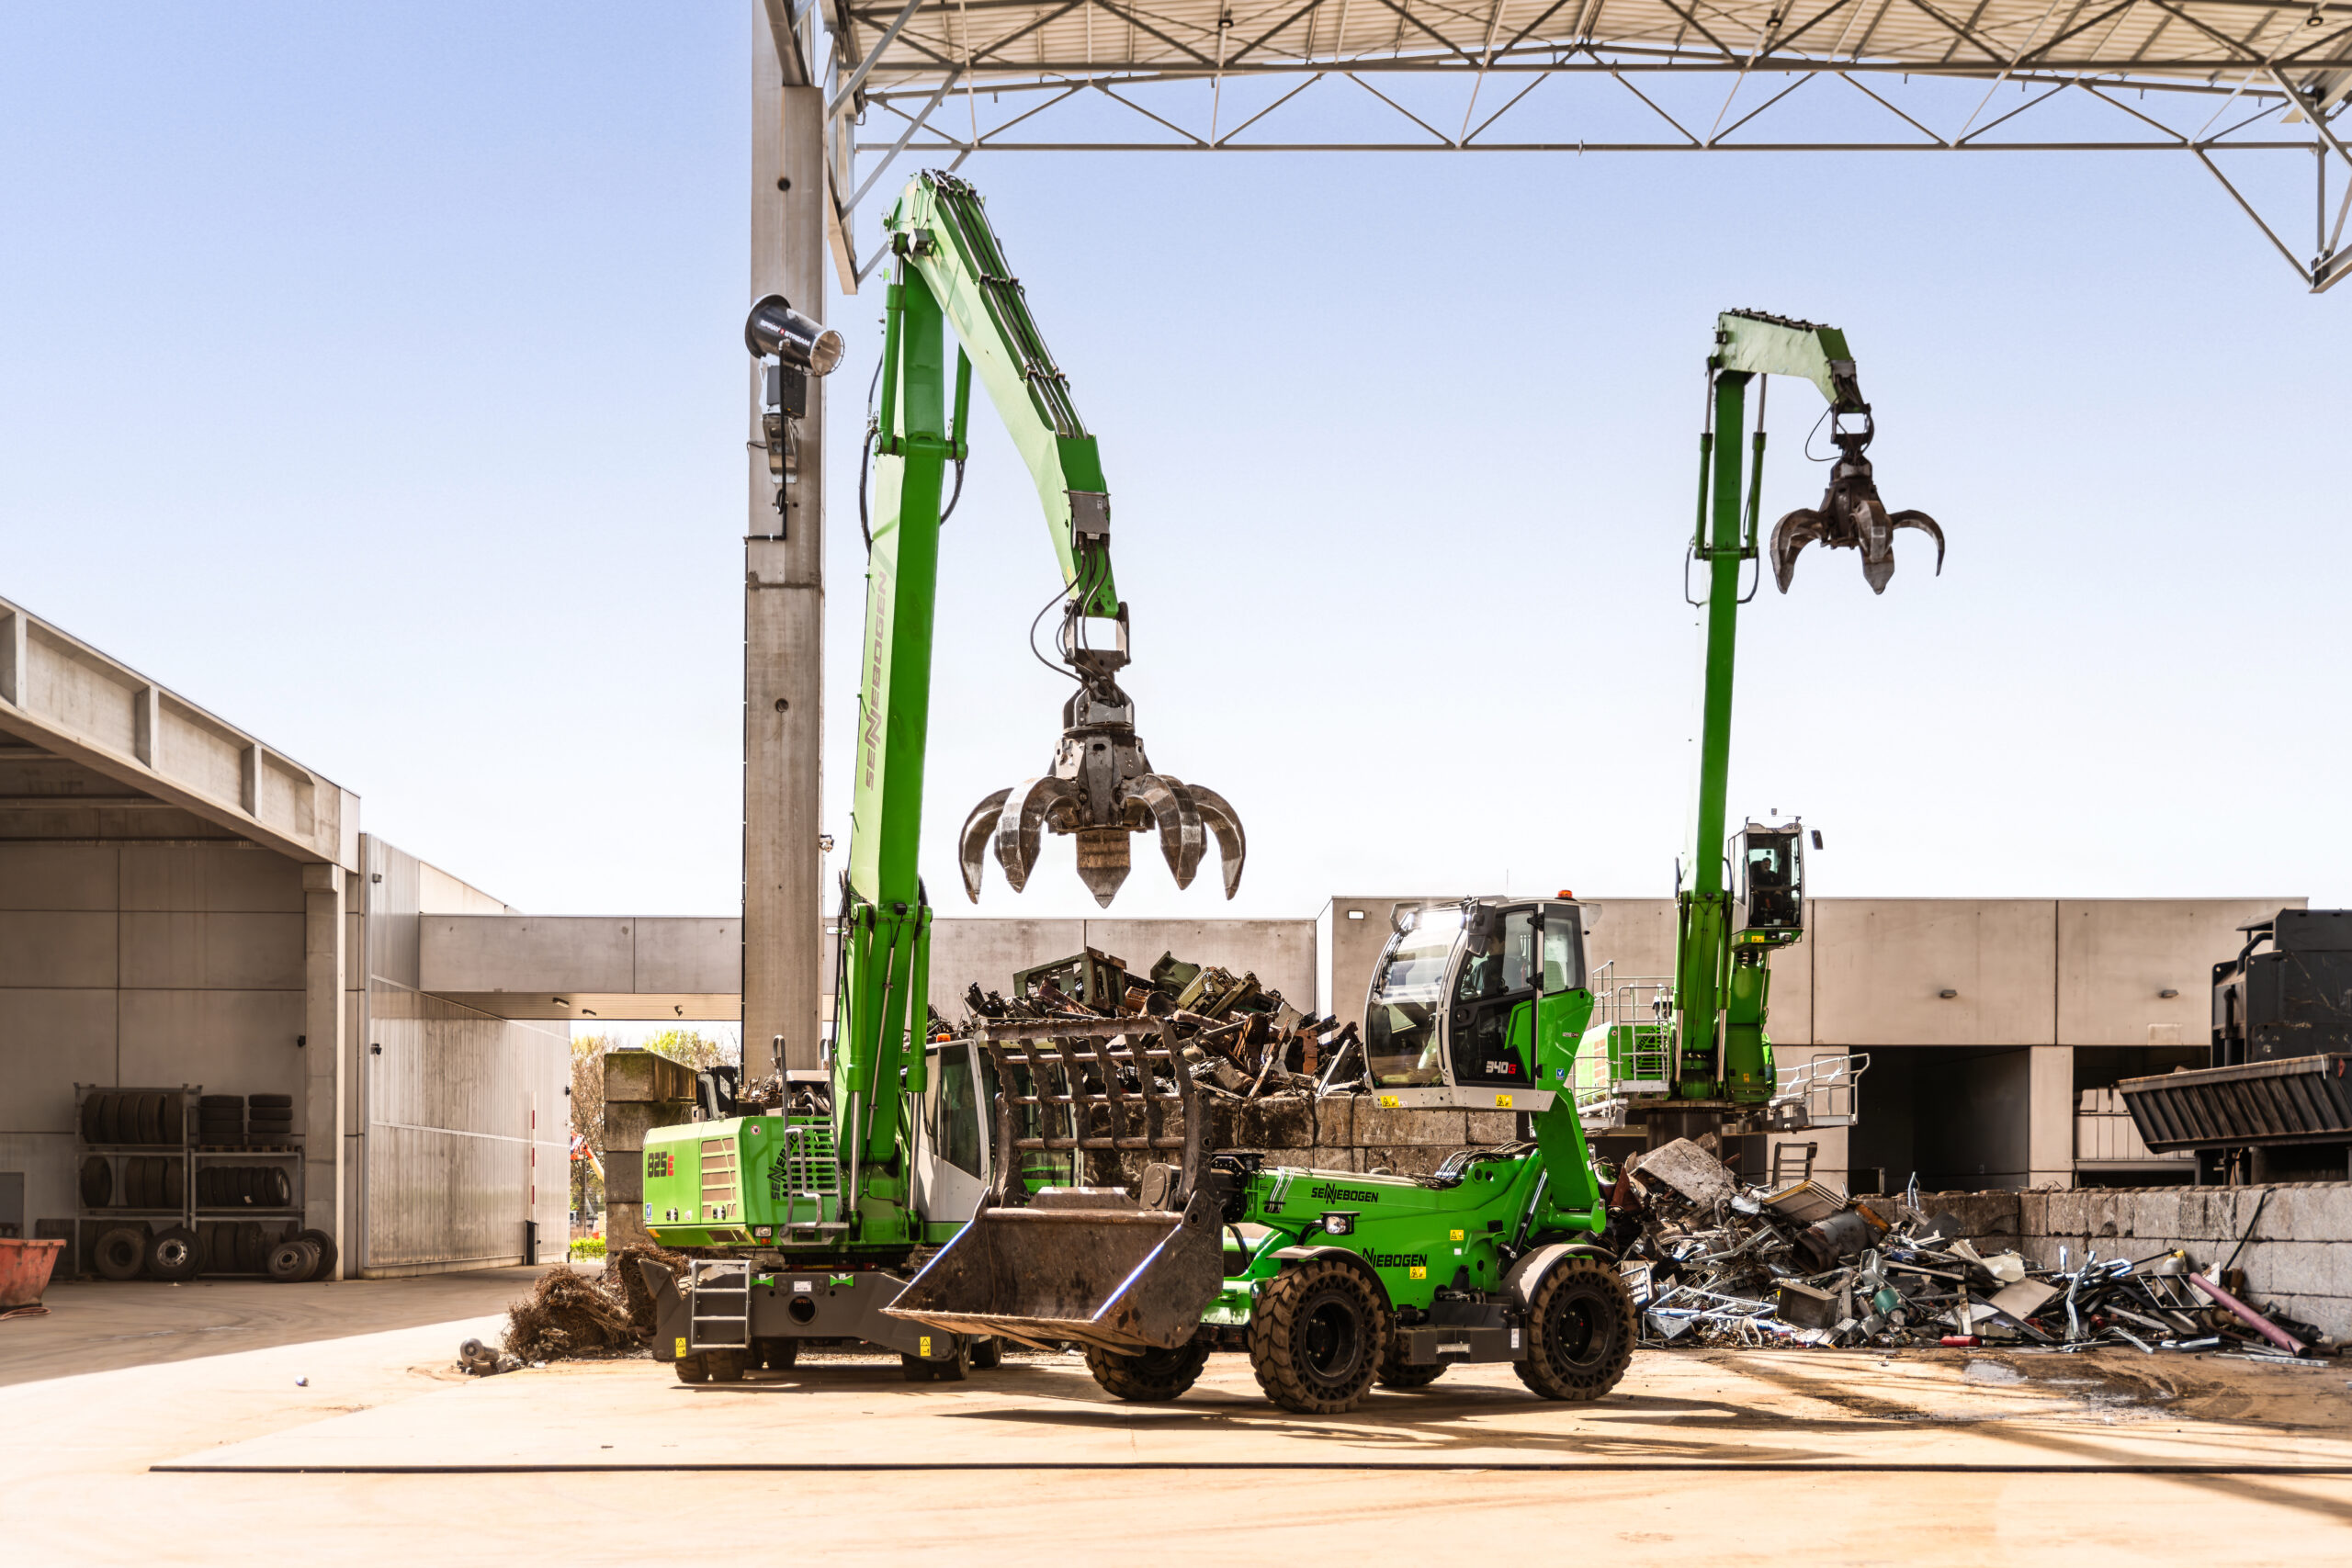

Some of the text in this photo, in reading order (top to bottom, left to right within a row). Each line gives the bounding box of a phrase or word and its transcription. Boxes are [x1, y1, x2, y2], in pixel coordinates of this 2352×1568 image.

[865, 570, 888, 792] SENNEBOGEN
[1486, 1060, 1517, 1075] 340G
[648, 1151, 674, 1178] 825E
[1311, 1182, 1379, 1205] SENNEBOGEN
